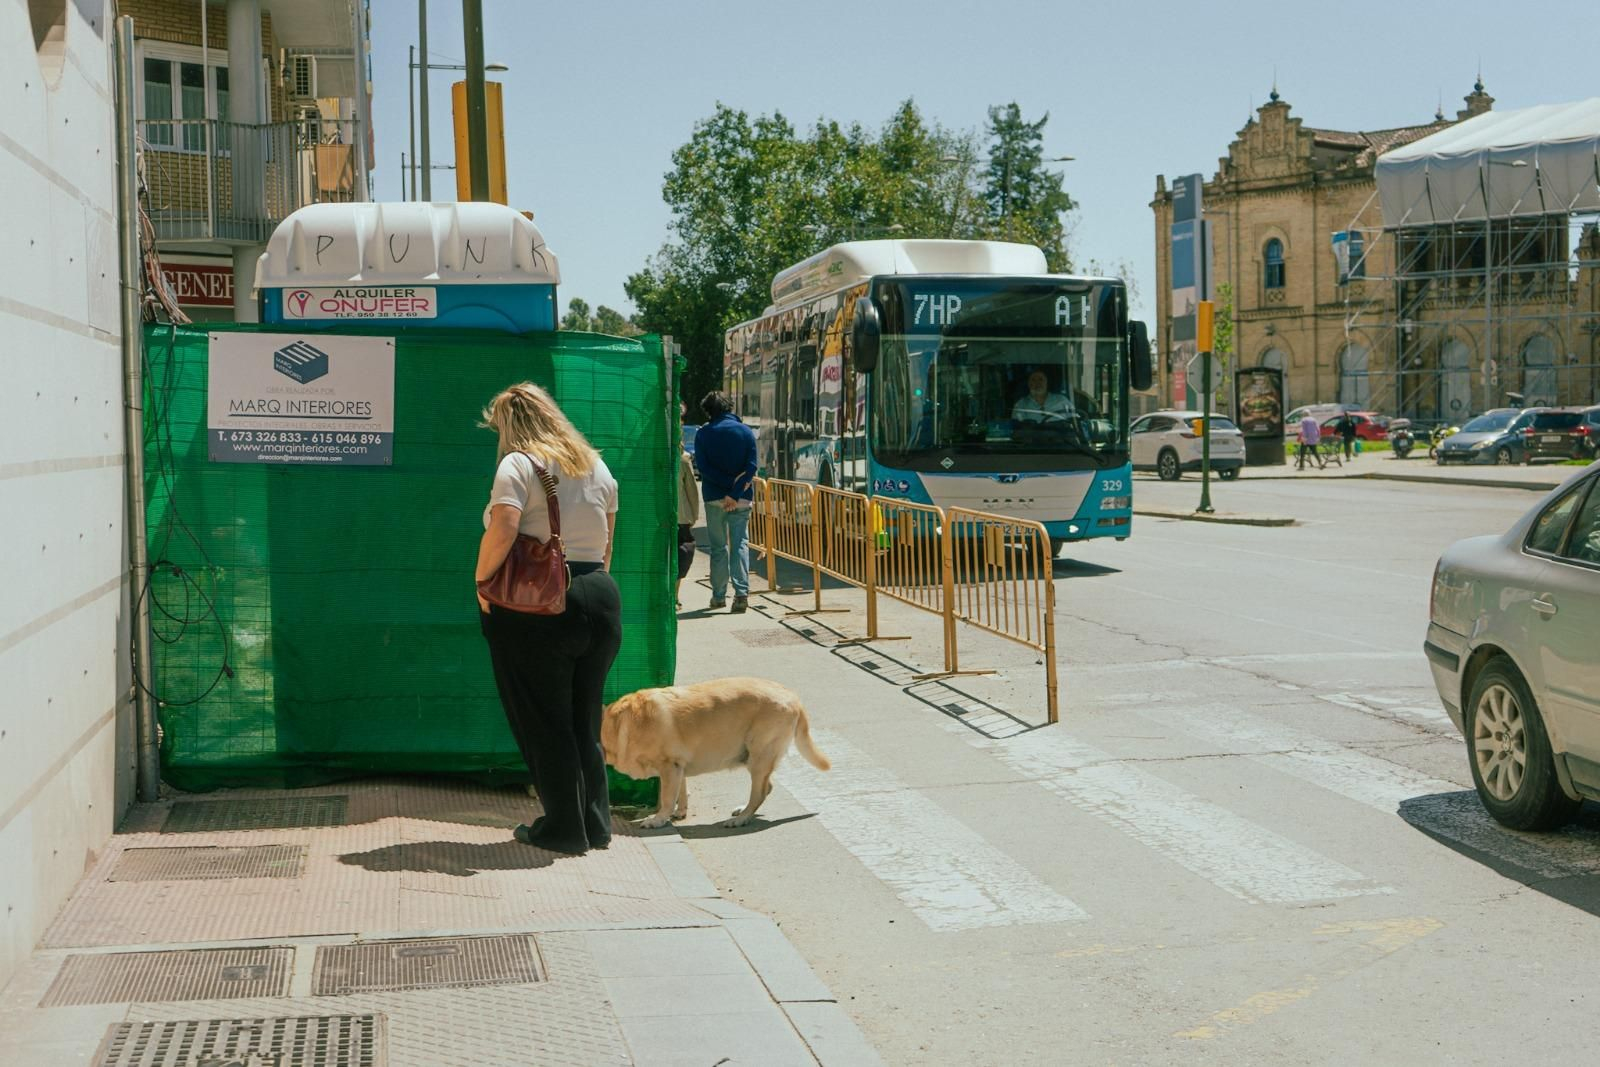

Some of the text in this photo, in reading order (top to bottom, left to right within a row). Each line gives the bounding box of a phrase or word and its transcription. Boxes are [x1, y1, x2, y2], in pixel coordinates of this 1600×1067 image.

[333, 289, 415, 298] ALQUILER
[320, 298, 429, 312] ONUFER
[914, 294, 962, 325] 7HP
[1055, 295, 1070, 325] A
[229, 399, 372, 415] MARQ INTERIORES
[218, 431, 227, 441] T.
[231, 431, 252, 441] 673
[256, 431, 277, 442] 326
[280, 432, 300, 442] 833
[312, 433, 332, 443] 615
[336, 434, 356, 444] 046
[361, 434, 381, 444] 896
[232, 443, 368, 454] www.marqinteriores.com
[1102, 480, 1123, 491] 329
